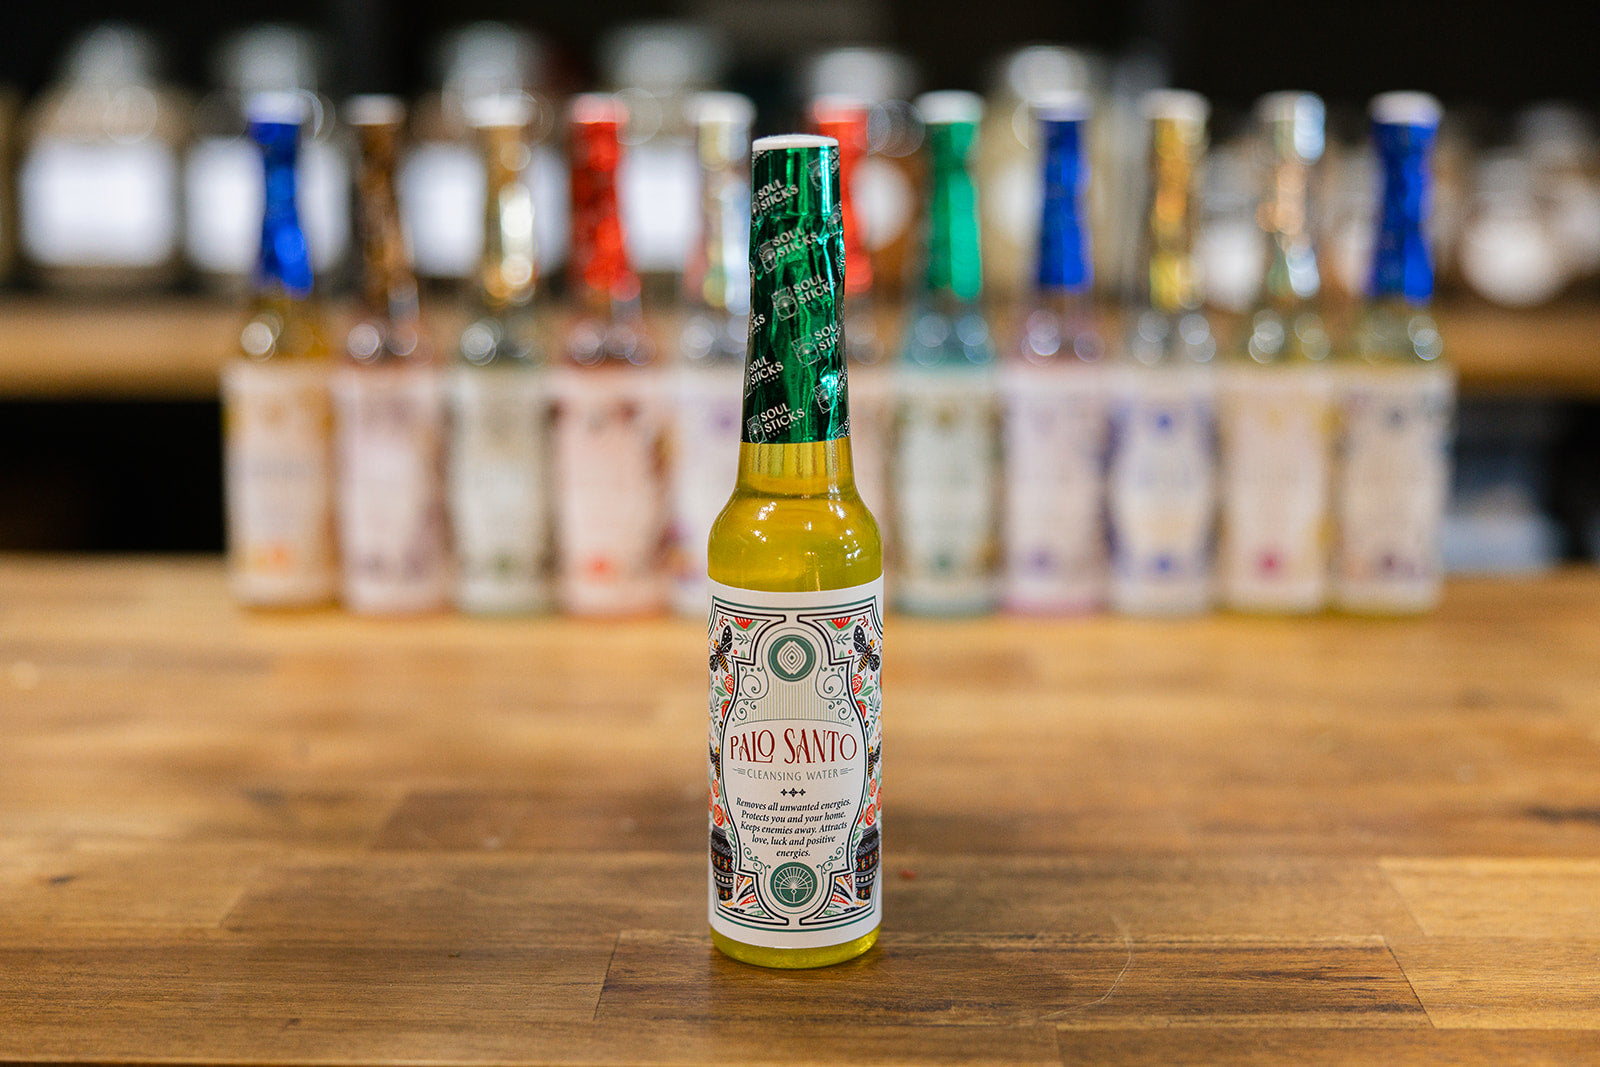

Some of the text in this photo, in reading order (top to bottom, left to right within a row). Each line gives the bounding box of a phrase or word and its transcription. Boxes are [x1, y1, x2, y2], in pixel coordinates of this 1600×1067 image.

[758, 179, 784, 200] SOUL
[760, 184, 799, 211] STICKS
[772, 227, 804, 247] SOUL
[776, 231, 818, 258] STICKS
[793, 274, 826, 294] SOUL
[814, 320, 839, 341] SOU
[749, 356, 770, 374] SOUL
[751, 361, 784, 385] STICKS
[760, 403, 791, 422] SOUL
[764, 408, 805, 433] STICKS
[730, 728, 857, 764] PALO SANTO
[747, 768, 839, 782] CLEANSING WATER
[736, 797, 851, 812] Removes all unwanted energies.
[741, 810, 846, 826] Protects you and your home.
[740, 821, 848, 837] Keeps enemies away. Attracts
[752, 834, 836, 847] love, luck and positive
[776, 848, 811, 860] energies.
